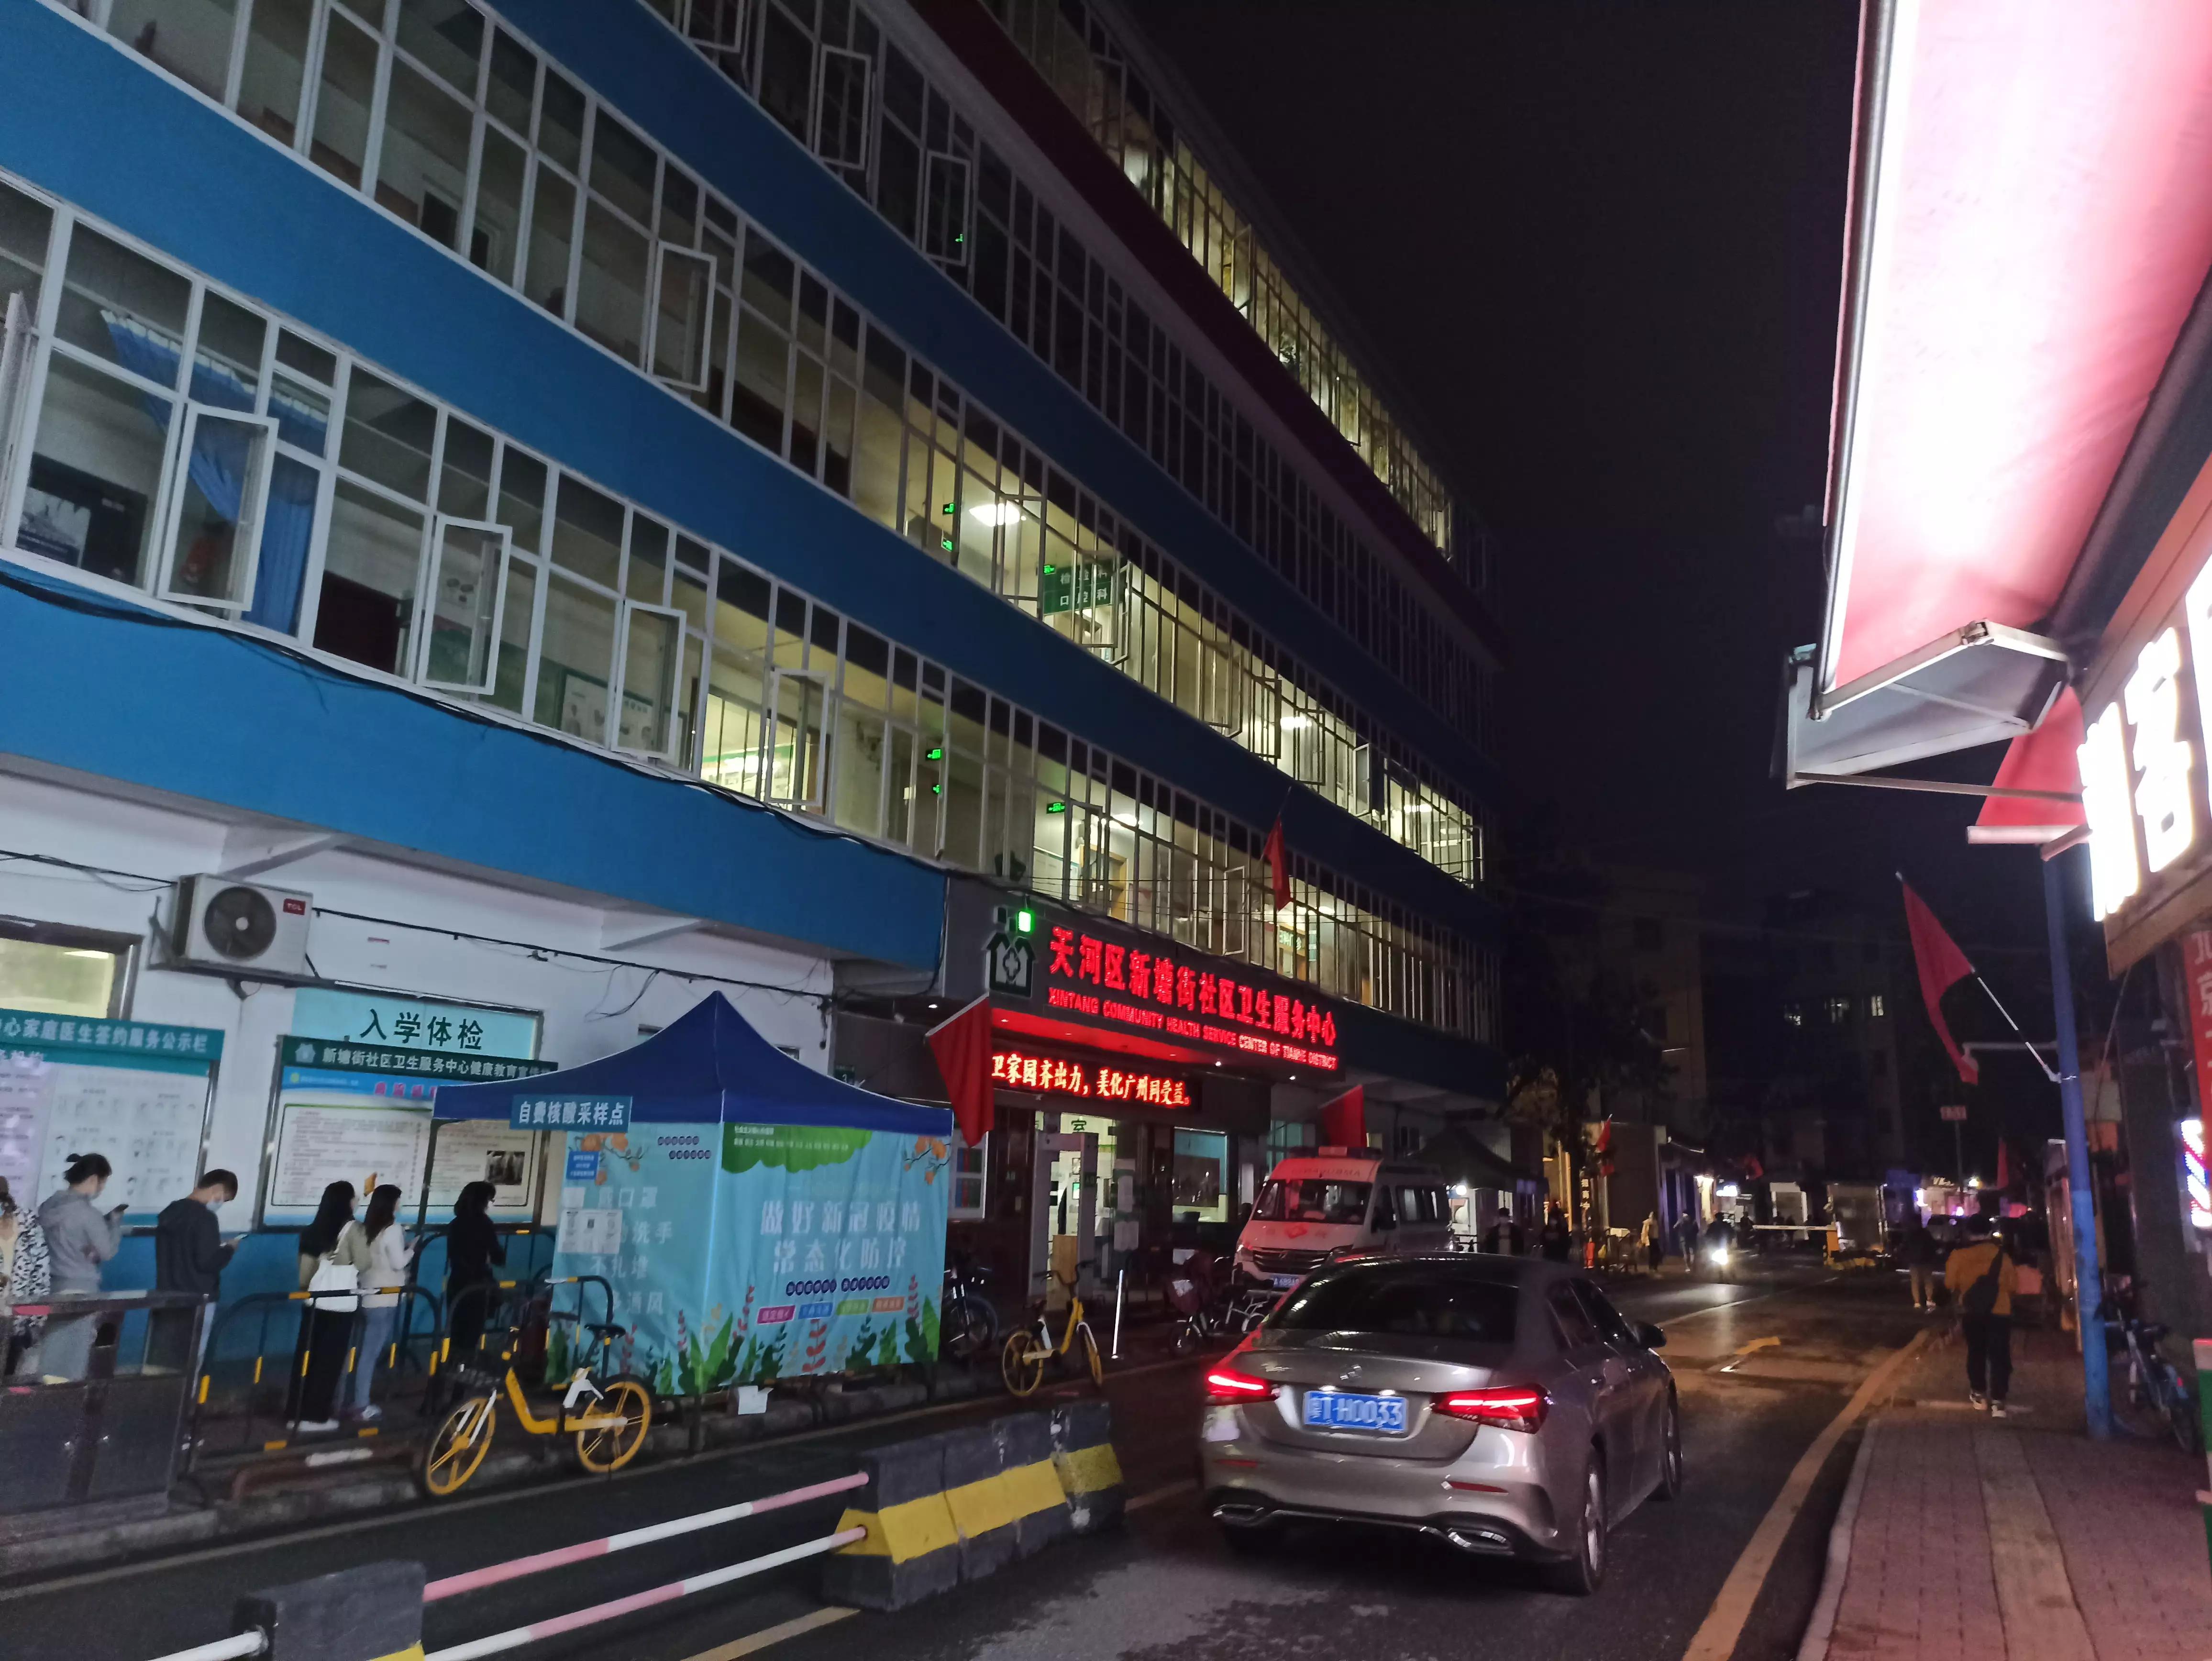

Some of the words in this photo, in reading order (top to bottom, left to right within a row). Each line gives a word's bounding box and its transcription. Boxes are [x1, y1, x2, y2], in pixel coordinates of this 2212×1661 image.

[1049, 926, 1338, 1047] 天河区新塘街社区卫生服务中心
[0, 1016, 208, 1052] 心家庭医生签约服务公示栏
[360, 1008, 484, 1050] 入学体检
[1049, 987, 1099, 1015] XINTANG
[1102, 999, 1164, 1029] COMMUNITY
[1166, 1017, 1201, 1038] HEALTH
[1203, 1025, 1237, 1046] SERVICE
[519, 1101, 624, 1125] 自费核酸采样点
[761, 1200, 920, 1235] 做好新冠疫情
[774, 1236, 907, 1274] 常态化防控
